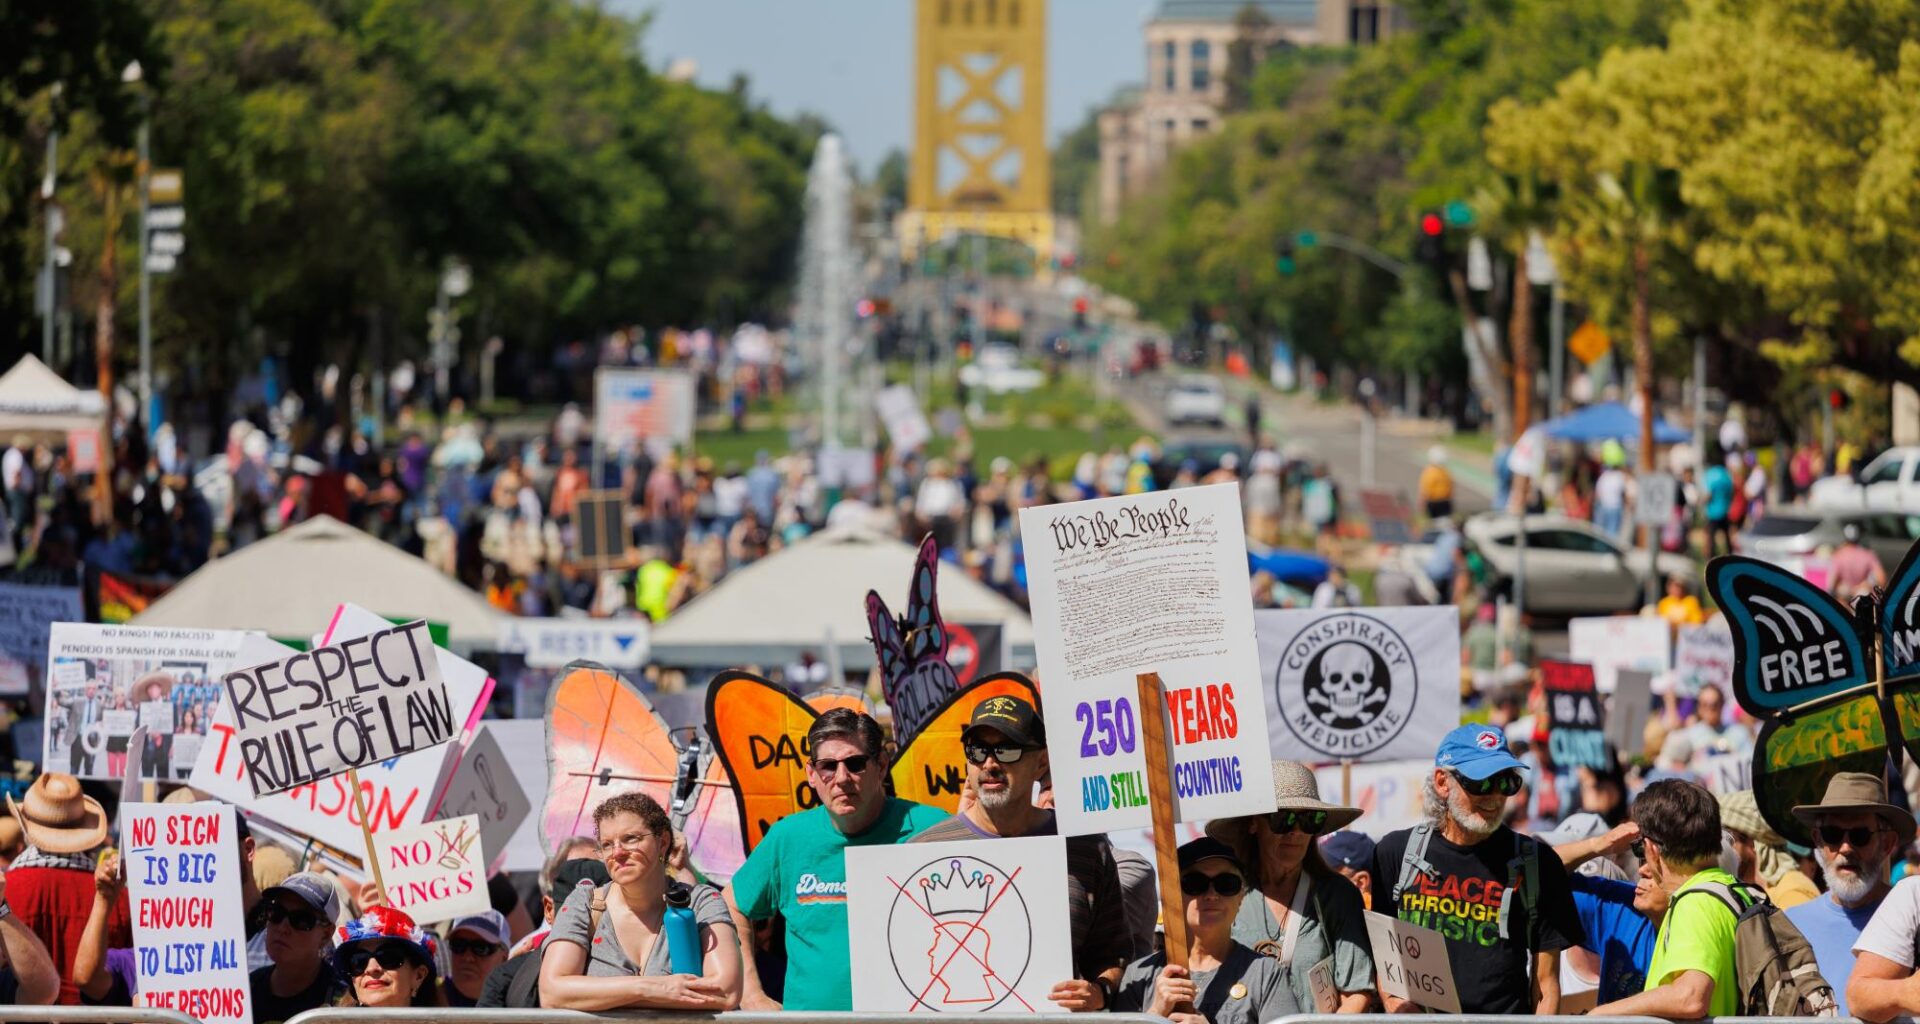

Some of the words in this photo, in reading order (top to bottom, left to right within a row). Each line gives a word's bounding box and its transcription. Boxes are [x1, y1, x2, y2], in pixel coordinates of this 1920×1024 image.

[1050, 515, 1091, 555] We
[1119, 498, 1190, 539] People
[61, 644, 103, 654] PENDEJO
[105, 645, 114, 654] IS
[116, 645, 156, 656] SPANISH
[158, 647, 176, 657] FOR
[179, 648, 210, 658] STABLE
[101, 628, 116, 638] NO
[118, 629, 151, 639] KINGS!
[153, 631, 168, 640] NO
[170, 630, 215, 641] FASCISTS!
[1287, 620, 1407, 671] CONSPIRACY
[225, 620, 427, 730] RESPECT
[1760, 640, 1847, 692] FREE
[323, 695, 365, 718] THE
[1075, 697, 1136, 758] 250
[1165, 682, 1238, 745] YEARS
[1576, 696, 1597, 725] A
[240, 721, 331, 796] RULE
[333, 707, 377, 767] OF
[377, 682, 454, 754] LAW
[1294, 709, 1400, 749] MEDICINE
[212, 722, 419, 834] TASON
[1082, 774, 1110, 812] AND
[1110, 770, 1148, 810] STILL
[1174, 756, 1243, 799] COUNTING
[132, 816, 156, 847] NO
[166, 813, 220, 846] SIGN
[143, 855, 168, 886] IS
[178, 852, 217, 884] BIG
[390, 840, 432, 870] NO
[139, 896, 214, 930] ENOUGH
[1403, 892, 1501, 924] THROUGH
[1398, 910, 1500, 947] MUSIC
[139, 946, 159, 977] TO
[165, 942, 205, 975] LIST
[210, 939, 238, 970] ALL
[1384, 960, 1445, 996] KINGS
[145, 991, 175, 1009] THE
